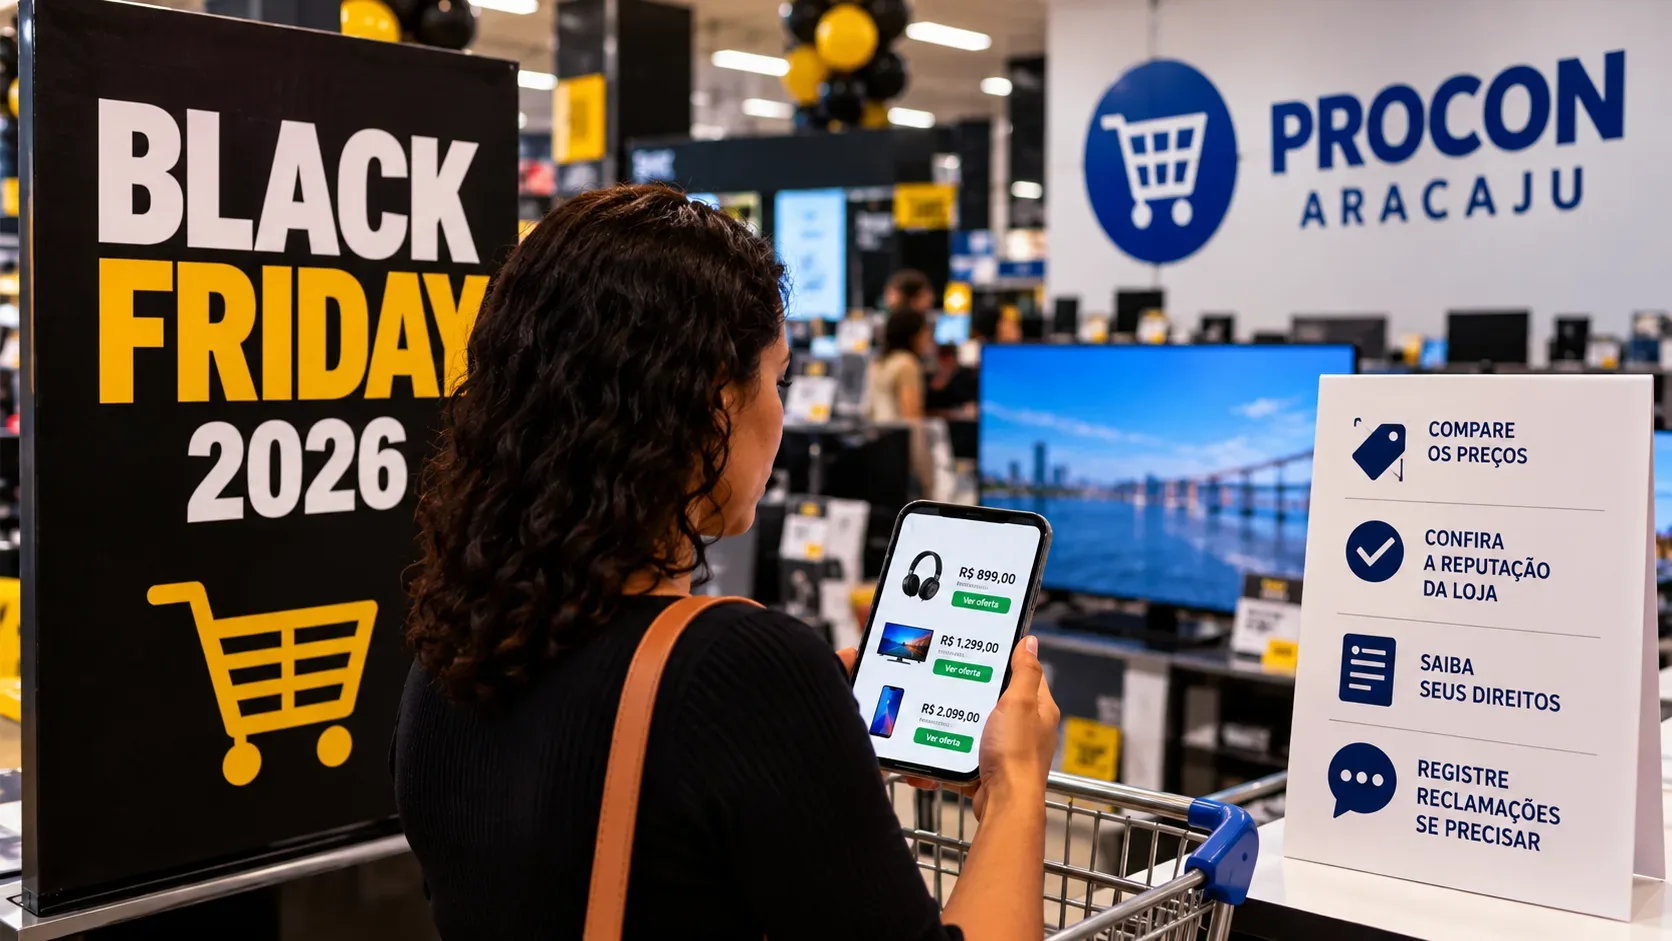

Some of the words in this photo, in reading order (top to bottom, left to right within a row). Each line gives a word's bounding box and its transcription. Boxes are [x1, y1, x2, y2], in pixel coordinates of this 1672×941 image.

[1271, 49, 1626, 175] PROCON
[99, 98, 480, 264] BLACK
[1300, 166, 1584, 228] ARACAJU
[99, 258, 490, 403] FRIDAY
[1429, 421, 1515, 438] COMPARE
[1428, 445, 1452, 462] OS
[1457, 446, 1528, 469] PREÇOS
[187, 416, 408, 523] 2026
[1425, 529, 1504, 550] CONFIRA
[959, 567, 974, 579] R$
[977, 570, 1015, 584] 899,00
[1424, 555, 1437, 572] A
[1442, 556, 1550, 582] REPUTAÇÃO
[963, 597, 975, 605] Ver
[976, 598, 999, 609] oferta
[1424, 580, 1447, 597] DA
[1453, 582, 1498, 602] LOJA
[940, 635, 954, 646] R$
[959, 666, 981, 677] oferta
[1421, 654, 1474, 675] SAIBA
[1420, 680, 1466, 701] SEUS
[1473, 686, 1560, 712] DIREITOS
[922, 704, 935, 715] R$
[937, 706, 979, 723] 2.099,00
[926, 733, 938, 742] Ver
[939, 736, 960, 746] oferta
[1418, 759, 1509, 790] REGISTRE
[1417, 787, 1561, 826] RECLAMAÇÕES
[1416, 815, 1438, 835] SE
[1446, 819, 1541, 852] PRECISAR
